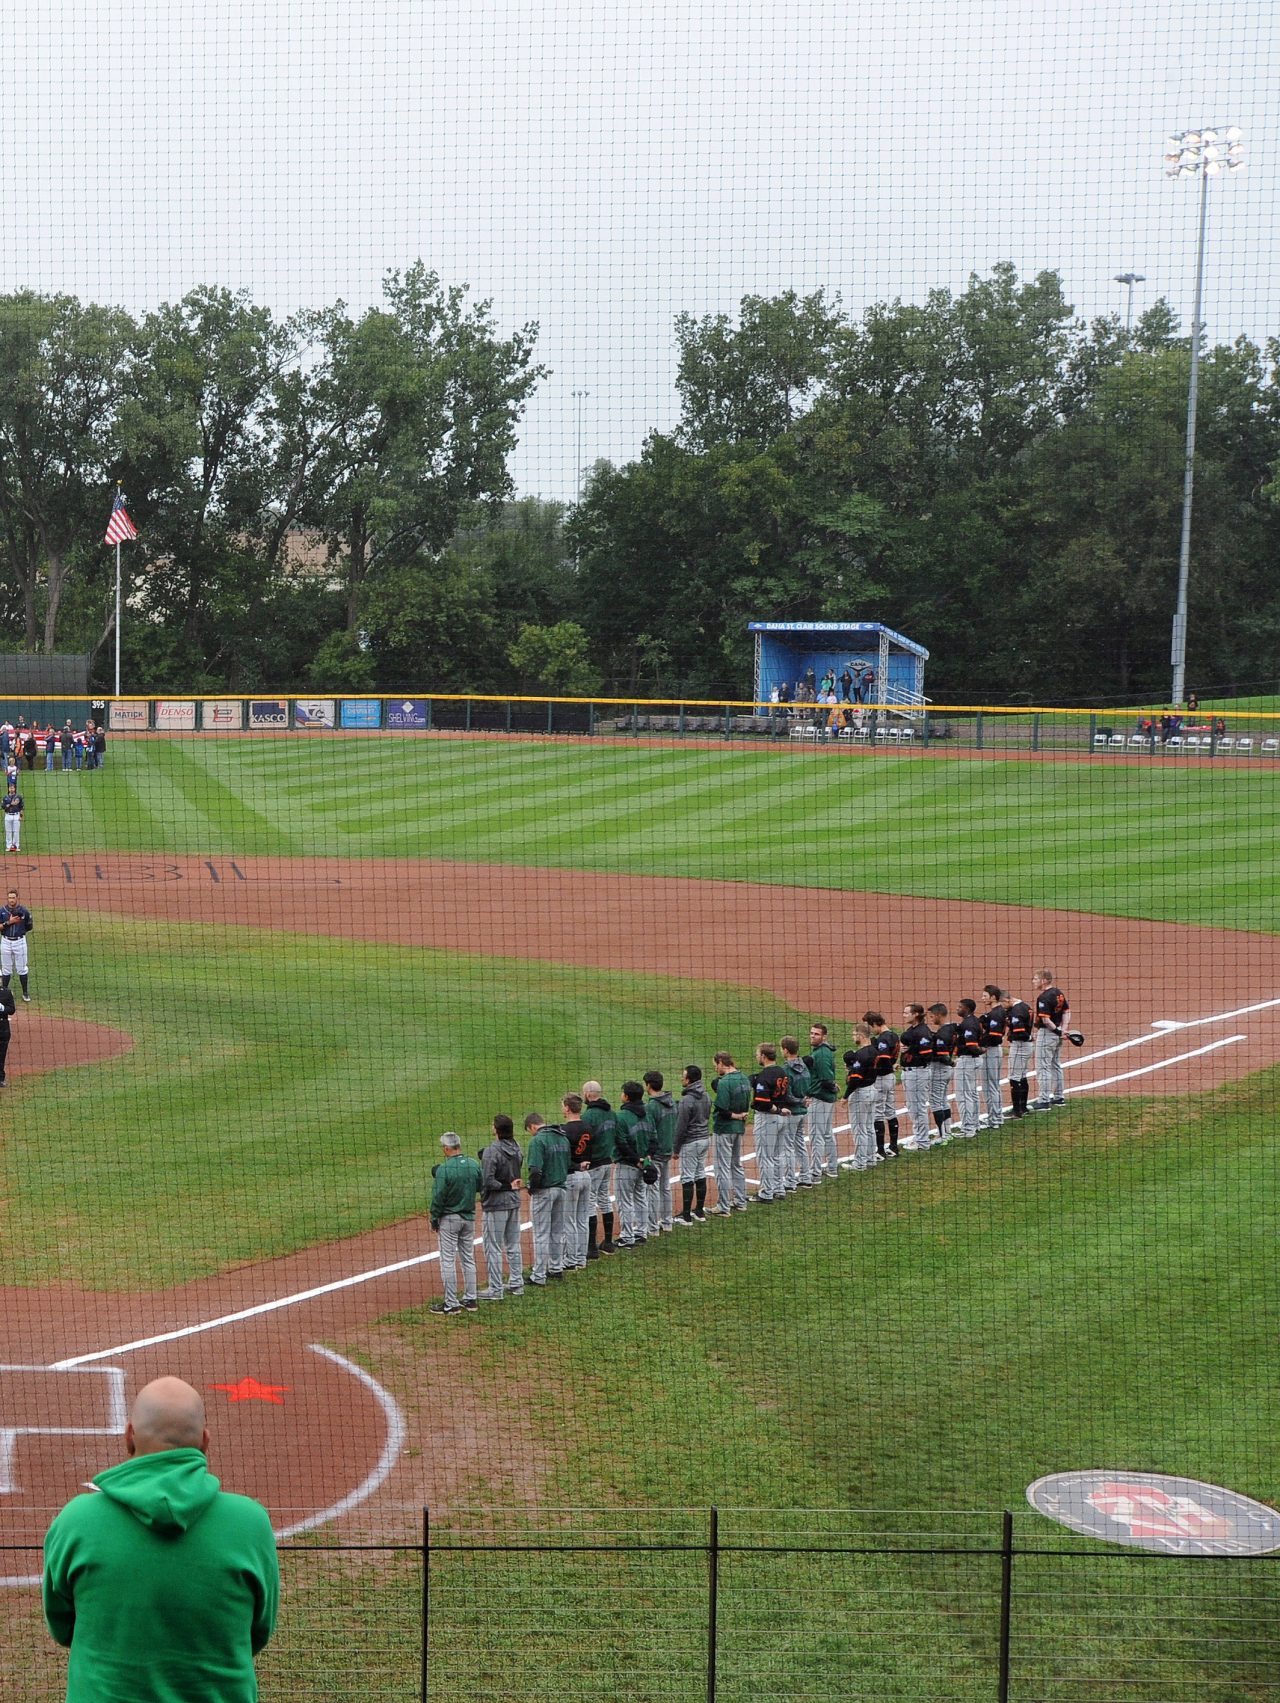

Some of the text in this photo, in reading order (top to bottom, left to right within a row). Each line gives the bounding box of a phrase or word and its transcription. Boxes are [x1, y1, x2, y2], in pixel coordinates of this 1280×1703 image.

[91, 701, 105, 709] 395
[114, 711, 144, 720] MATICK
[160, 708, 194, 716] DENSO
[253, 713, 286, 723] KASCO
